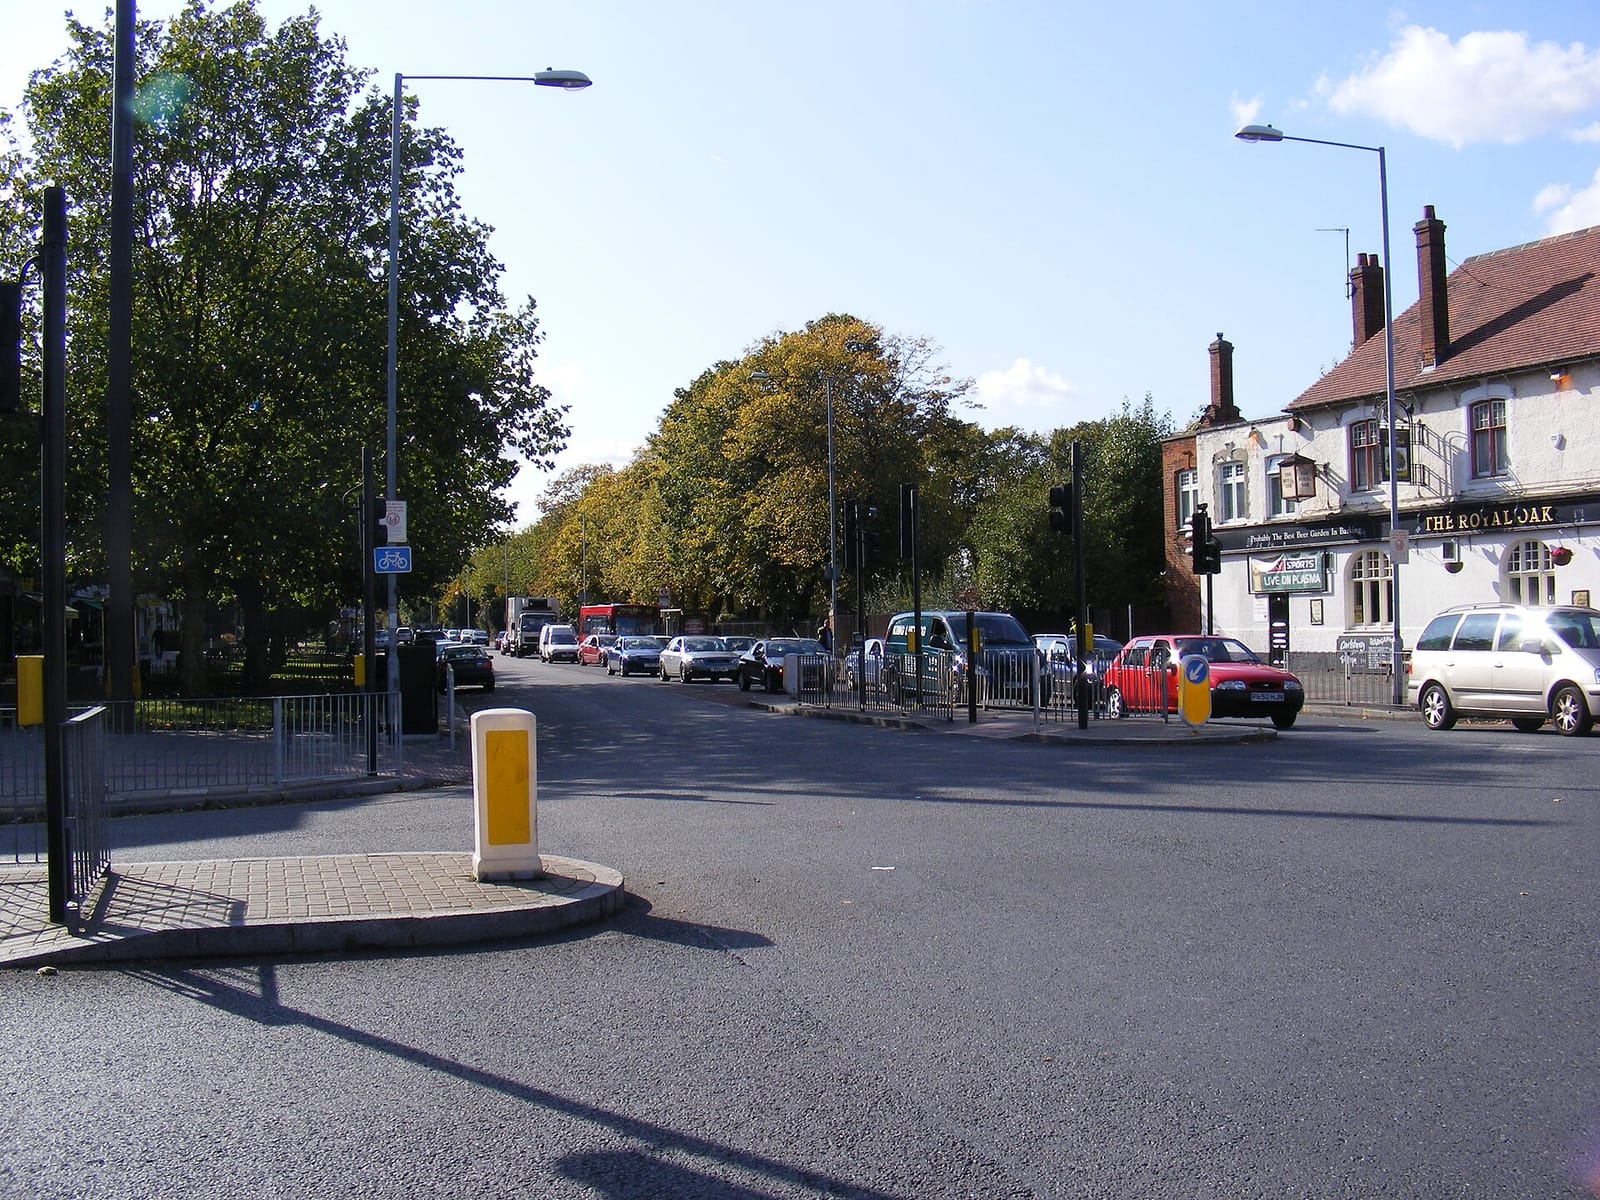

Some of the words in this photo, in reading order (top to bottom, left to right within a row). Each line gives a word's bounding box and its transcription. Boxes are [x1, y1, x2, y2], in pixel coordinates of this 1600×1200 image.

[1425, 515, 1454, 532] THE
[1459, 509, 1513, 529] ROYAL
[1516, 506, 1554, 526] OAK
[1250, 533, 1271, 543] Probably
[1272, 533, 1282, 541] The
[1284, 532, 1295, 540] Best
[1296, 531, 1309, 539] Beer
[1310, 529, 1330, 538] Garden
[1331, 528, 1338, 536] In
[1286, 560, 1315, 570] SPORTS
[1263, 576, 1280, 586] LIVE
[1281, 575, 1291, 585] ON
[1292, 573, 1321, 585] PLASMA
